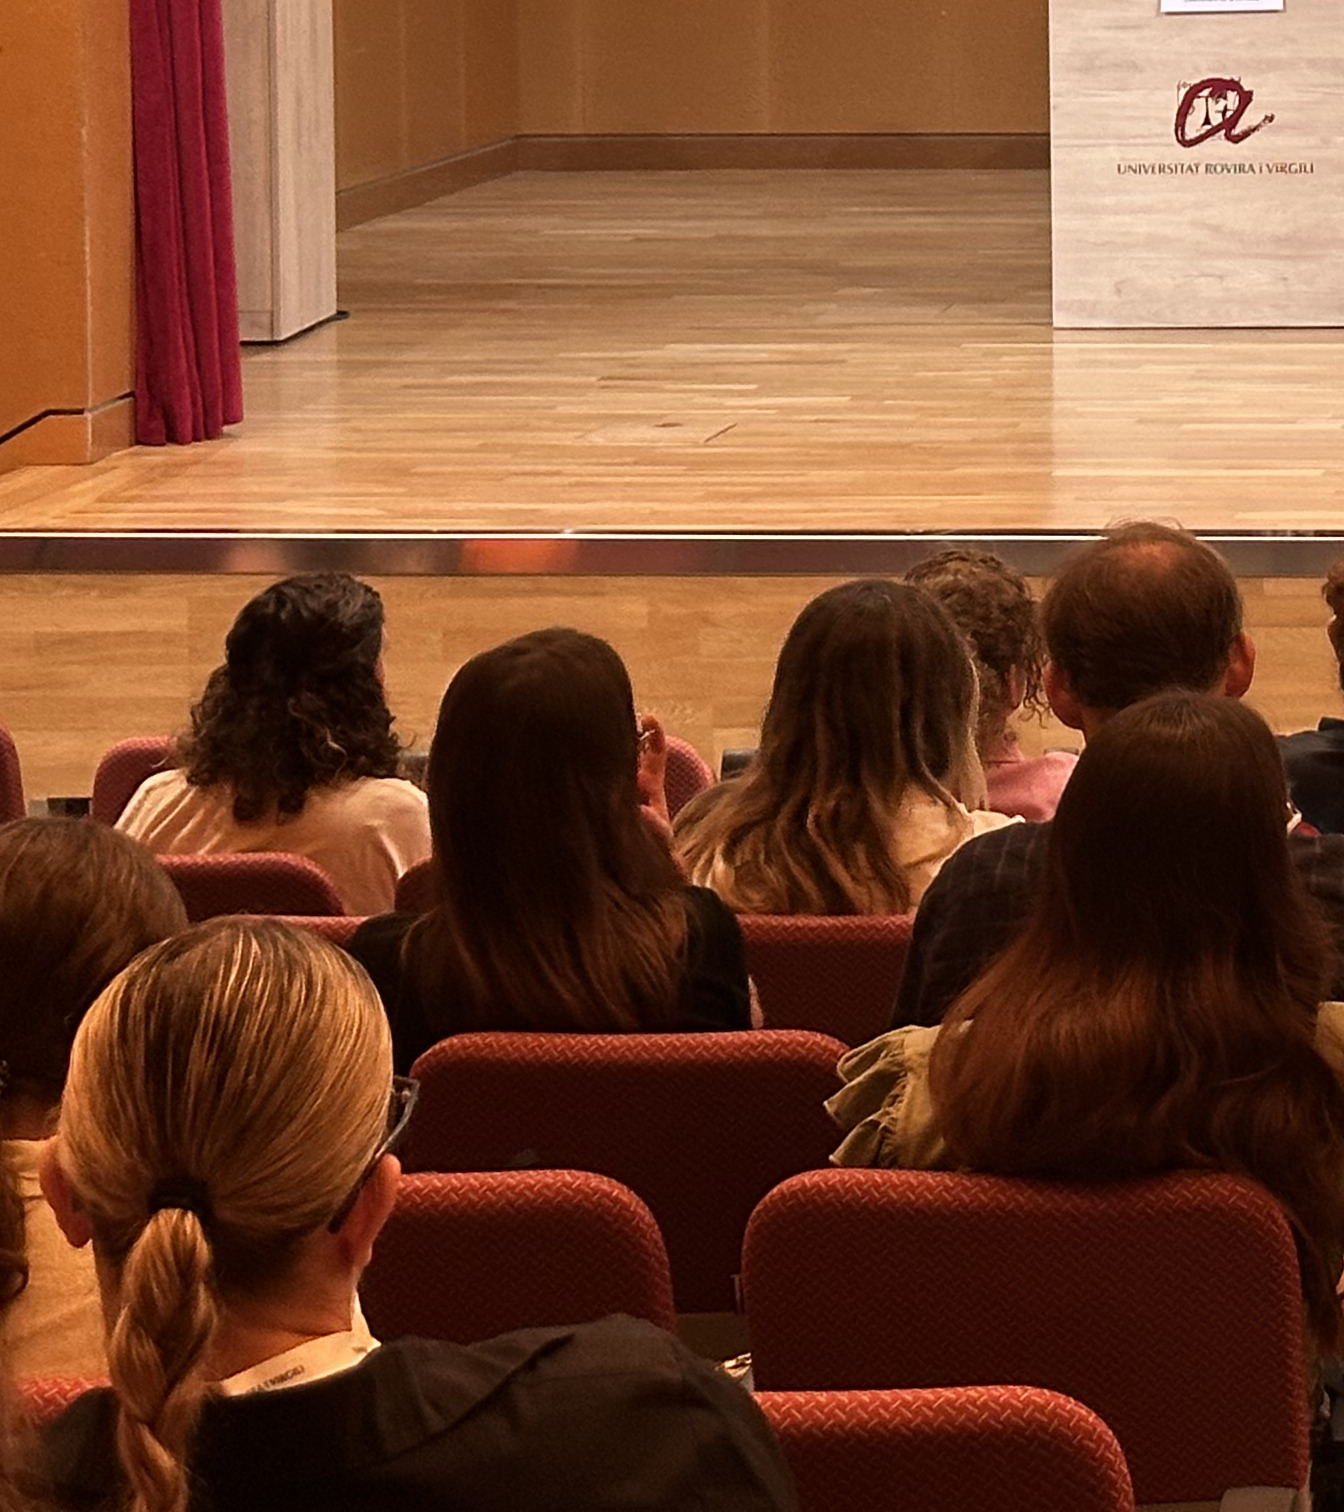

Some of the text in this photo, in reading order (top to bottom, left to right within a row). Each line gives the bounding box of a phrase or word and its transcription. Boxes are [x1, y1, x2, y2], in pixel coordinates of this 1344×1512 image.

[1116, 162, 1201, 175] UNIVERSITAT
[1204, 163, 1257, 175] ROVIRA
[1265, 162, 1315, 175] VIRGILI
